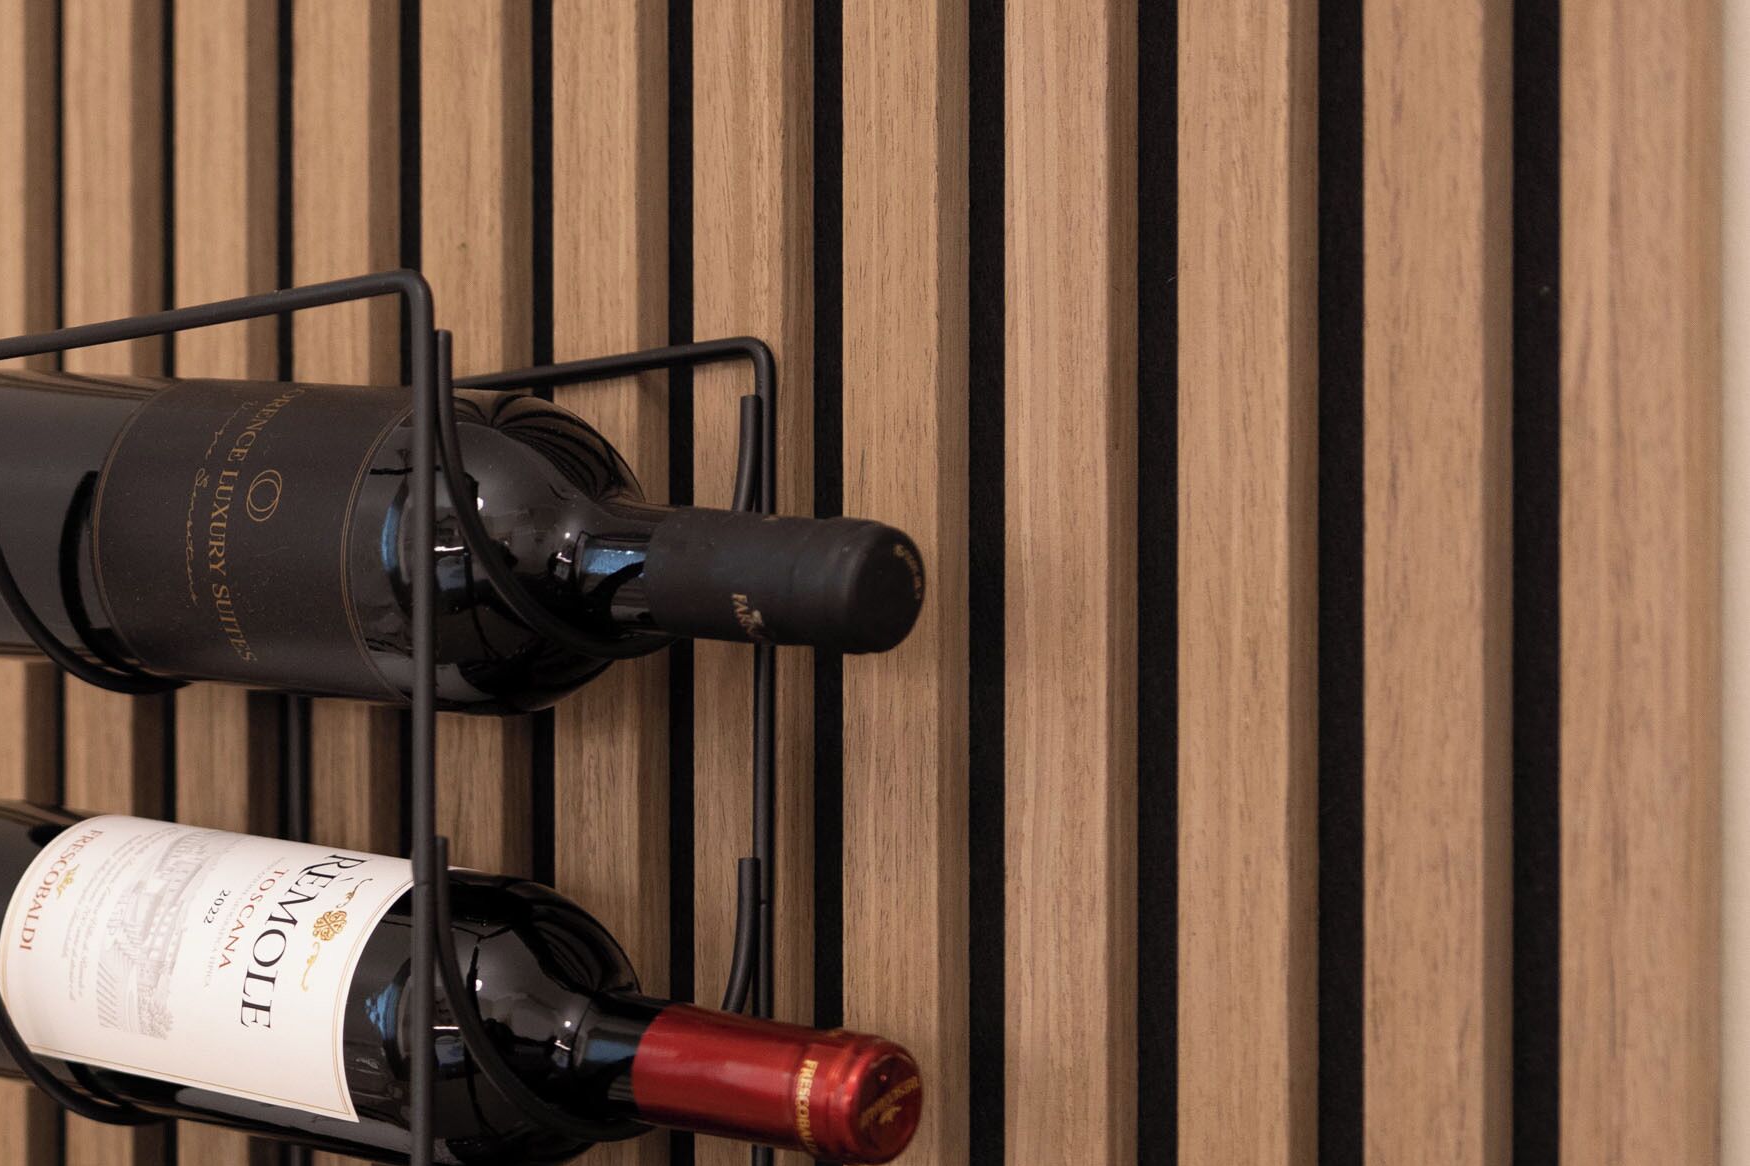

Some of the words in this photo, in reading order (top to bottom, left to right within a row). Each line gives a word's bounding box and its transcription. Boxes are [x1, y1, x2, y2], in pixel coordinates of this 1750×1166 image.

[208, 469, 239, 577] LUXURY
[212, 583, 257, 663] SUITES
[19, 829, 104, 951] FRESCOBALDI
[203, 887, 231, 924] 2022
[218, 867, 290, 968] TOSCANA
[240, 854, 368, 1029] RÈMOLE
